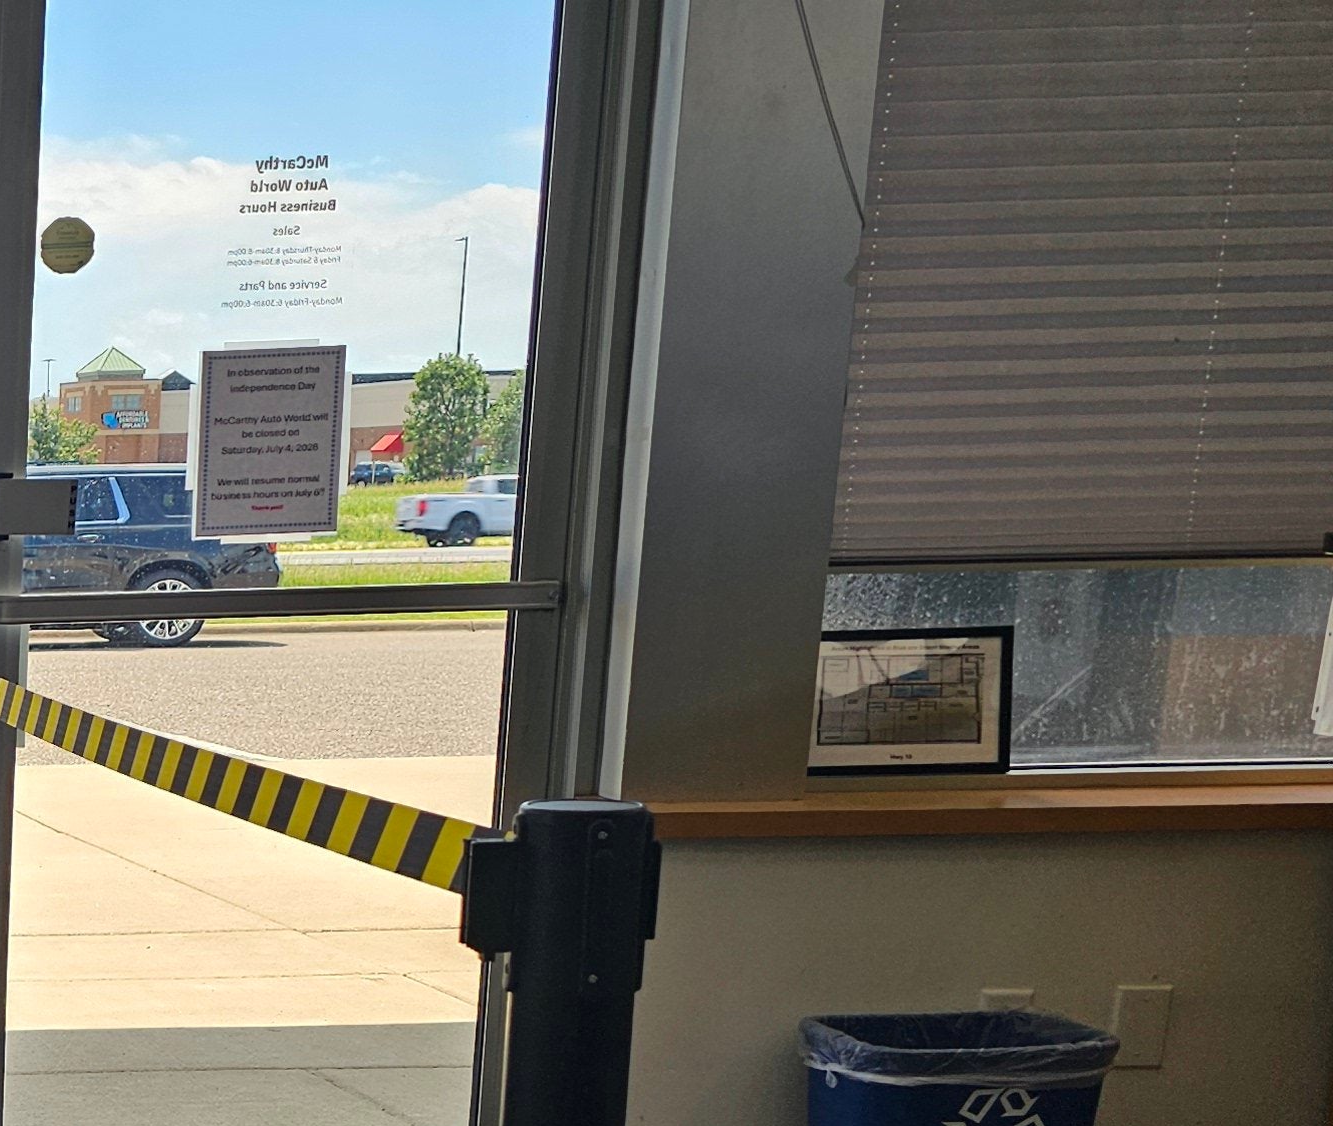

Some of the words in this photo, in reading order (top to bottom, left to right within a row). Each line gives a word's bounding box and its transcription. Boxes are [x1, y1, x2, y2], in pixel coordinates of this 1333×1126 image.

[227, 369, 236, 377] In
[238, 367, 292, 376] observation
[294, 366, 303, 374] of
[305, 365, 320, 374] the
[298, 382, 316, 392] Day
[214, 416, 259, 426] McCarthy
[260, 415, 281, 424] Auto
[284, 414, 311, 423] World
[312, 413, 329, 422] will
[241, 430, 253, 438] be
[255, 429, 285, 438] closed
[288, 429, 300, 437] on
[265, 445, 283, 454] July
[217, 478, 233, 487] We
[234, 477, 249, 486] will
[251, 477, 286, 485] resume
[287, 475, 320, 484] normal
[211, 492, 251, 501] business
[253, 490, 279, 499] hours
[281, 490, 293, 499] on
[294, 488, 312, 498] July
[68, 486, 77, 528] PUSH
